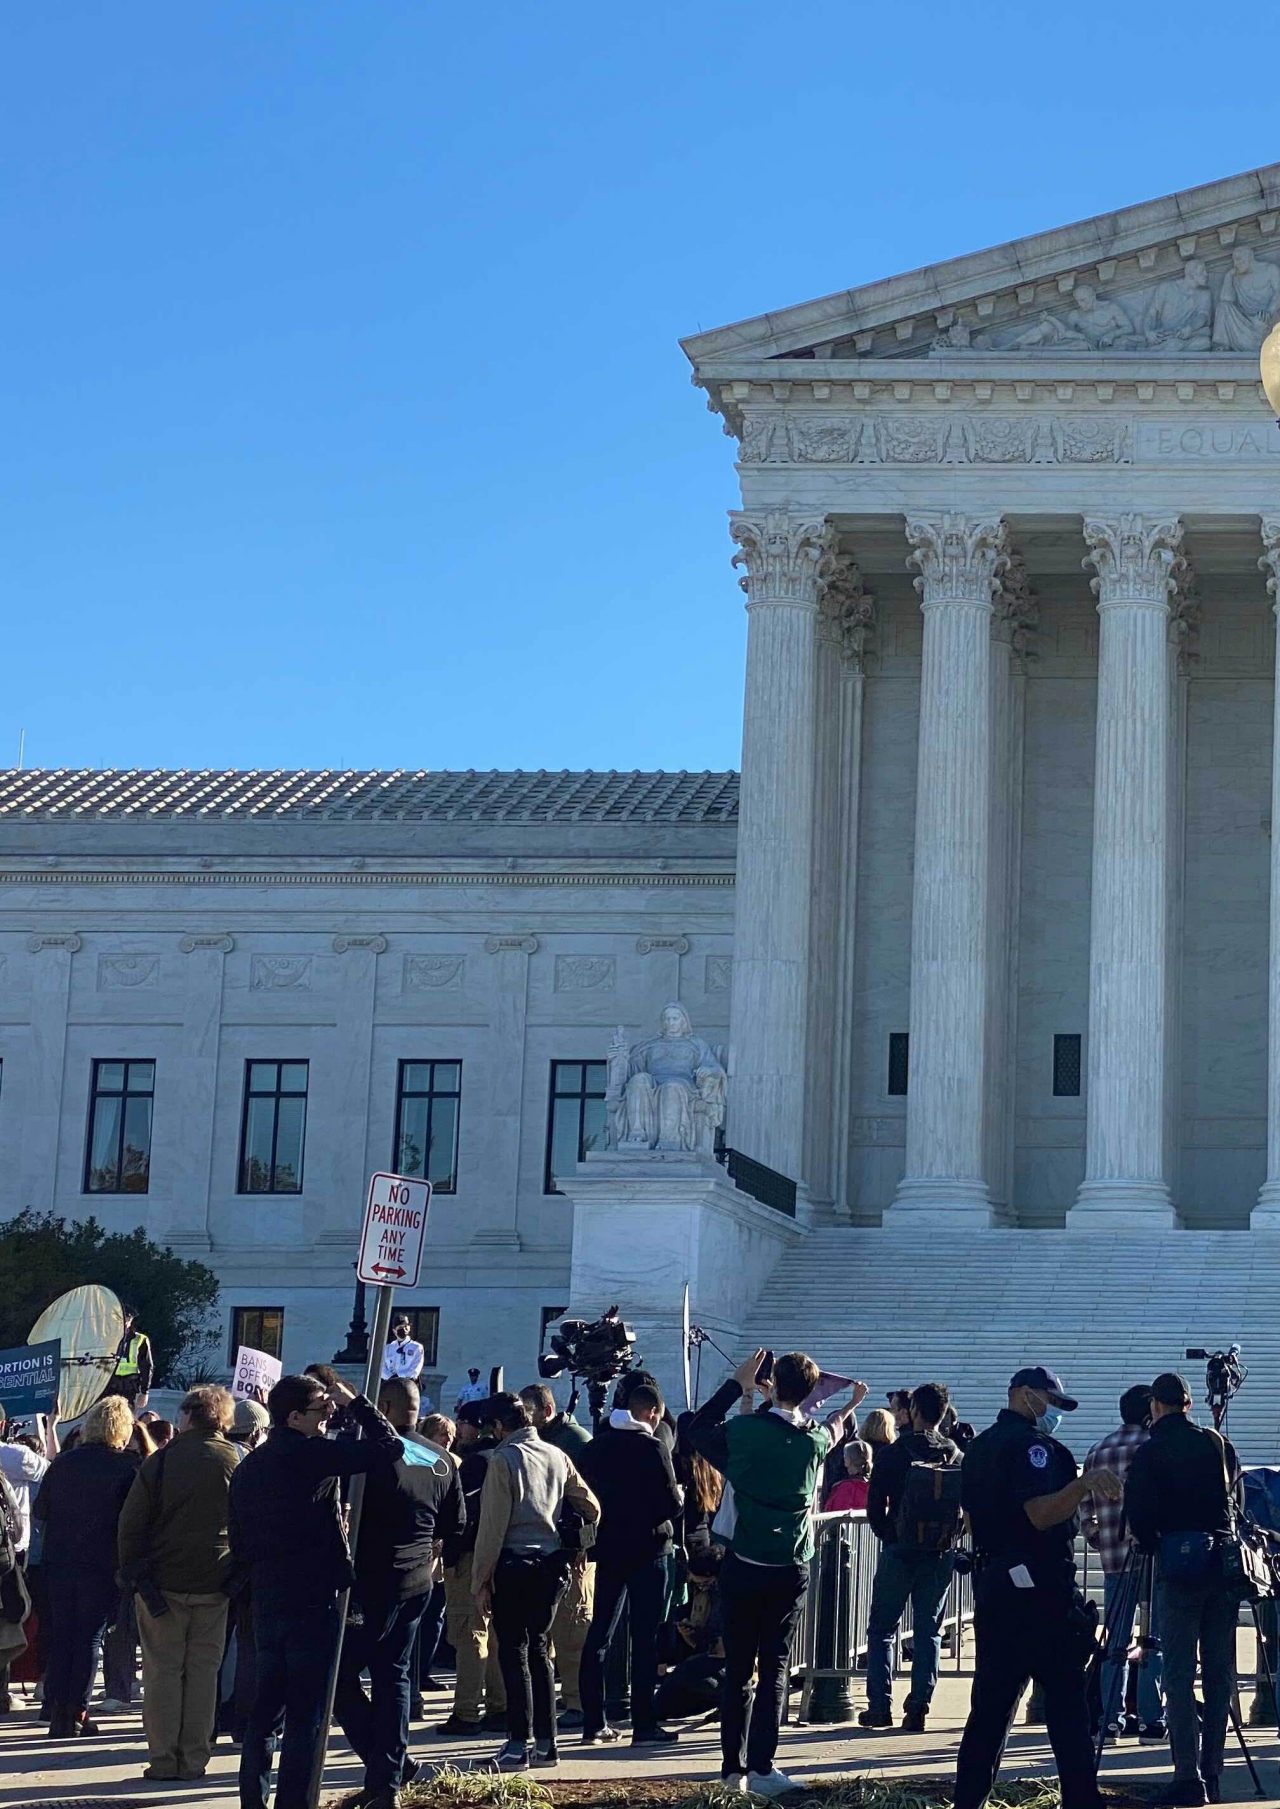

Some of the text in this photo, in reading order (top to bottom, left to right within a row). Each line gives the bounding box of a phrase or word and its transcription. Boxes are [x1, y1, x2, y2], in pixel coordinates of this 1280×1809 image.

[1158, 428, 1280, 456] EQUAL
[388, 1185, 410, 1206] NO
[372, 1203, 421, 1229] PARKING
[380, 1228, 407, 1246] ANY
[378, 1244, 405, 1264] TIME
[43, 1354, 53, 1367] IS
[241, 1353, 267, 1372] BANS
[239, 1367, 261, 1381] OFF
